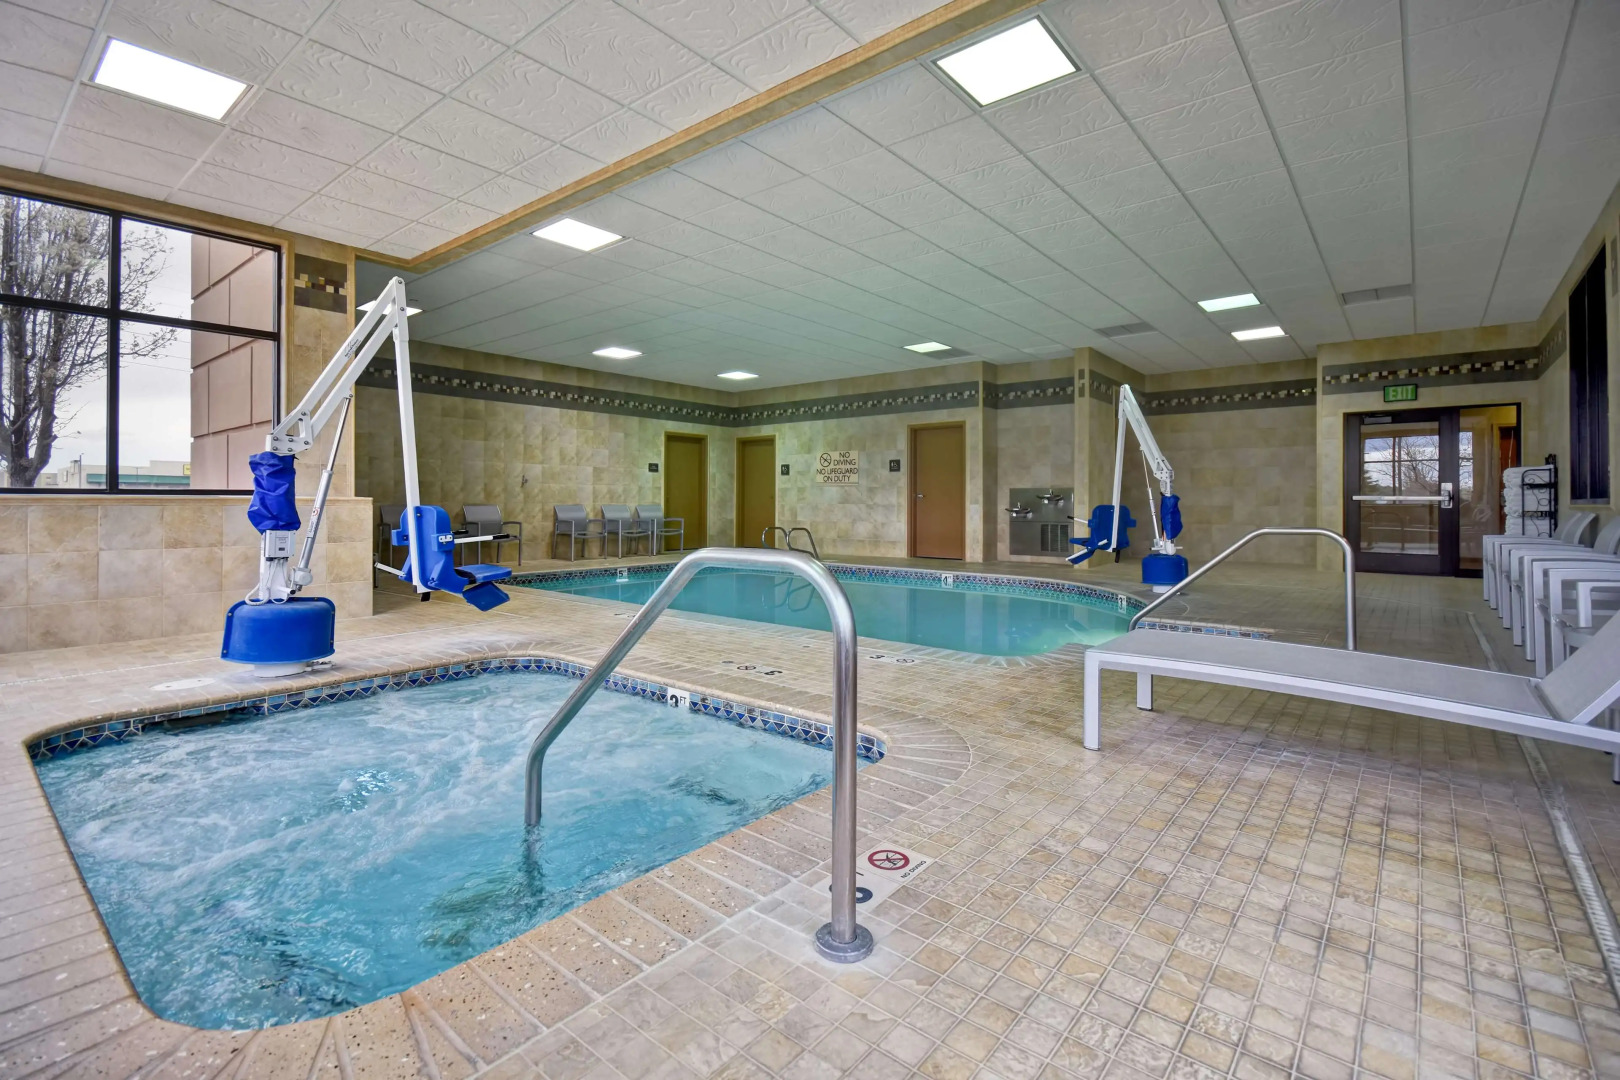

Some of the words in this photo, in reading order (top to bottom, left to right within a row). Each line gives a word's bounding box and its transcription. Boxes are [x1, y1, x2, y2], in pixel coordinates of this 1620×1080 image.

[1389, 387, 1415, 400] EXIT
[839, 451, 851, 459] NO
[826, 467, 859, 475] LIFEGUARD
[679, 695, 687, 704] FT
[900, 871, 911, 879] NO
[908, 860, 927, 873] DIVING
